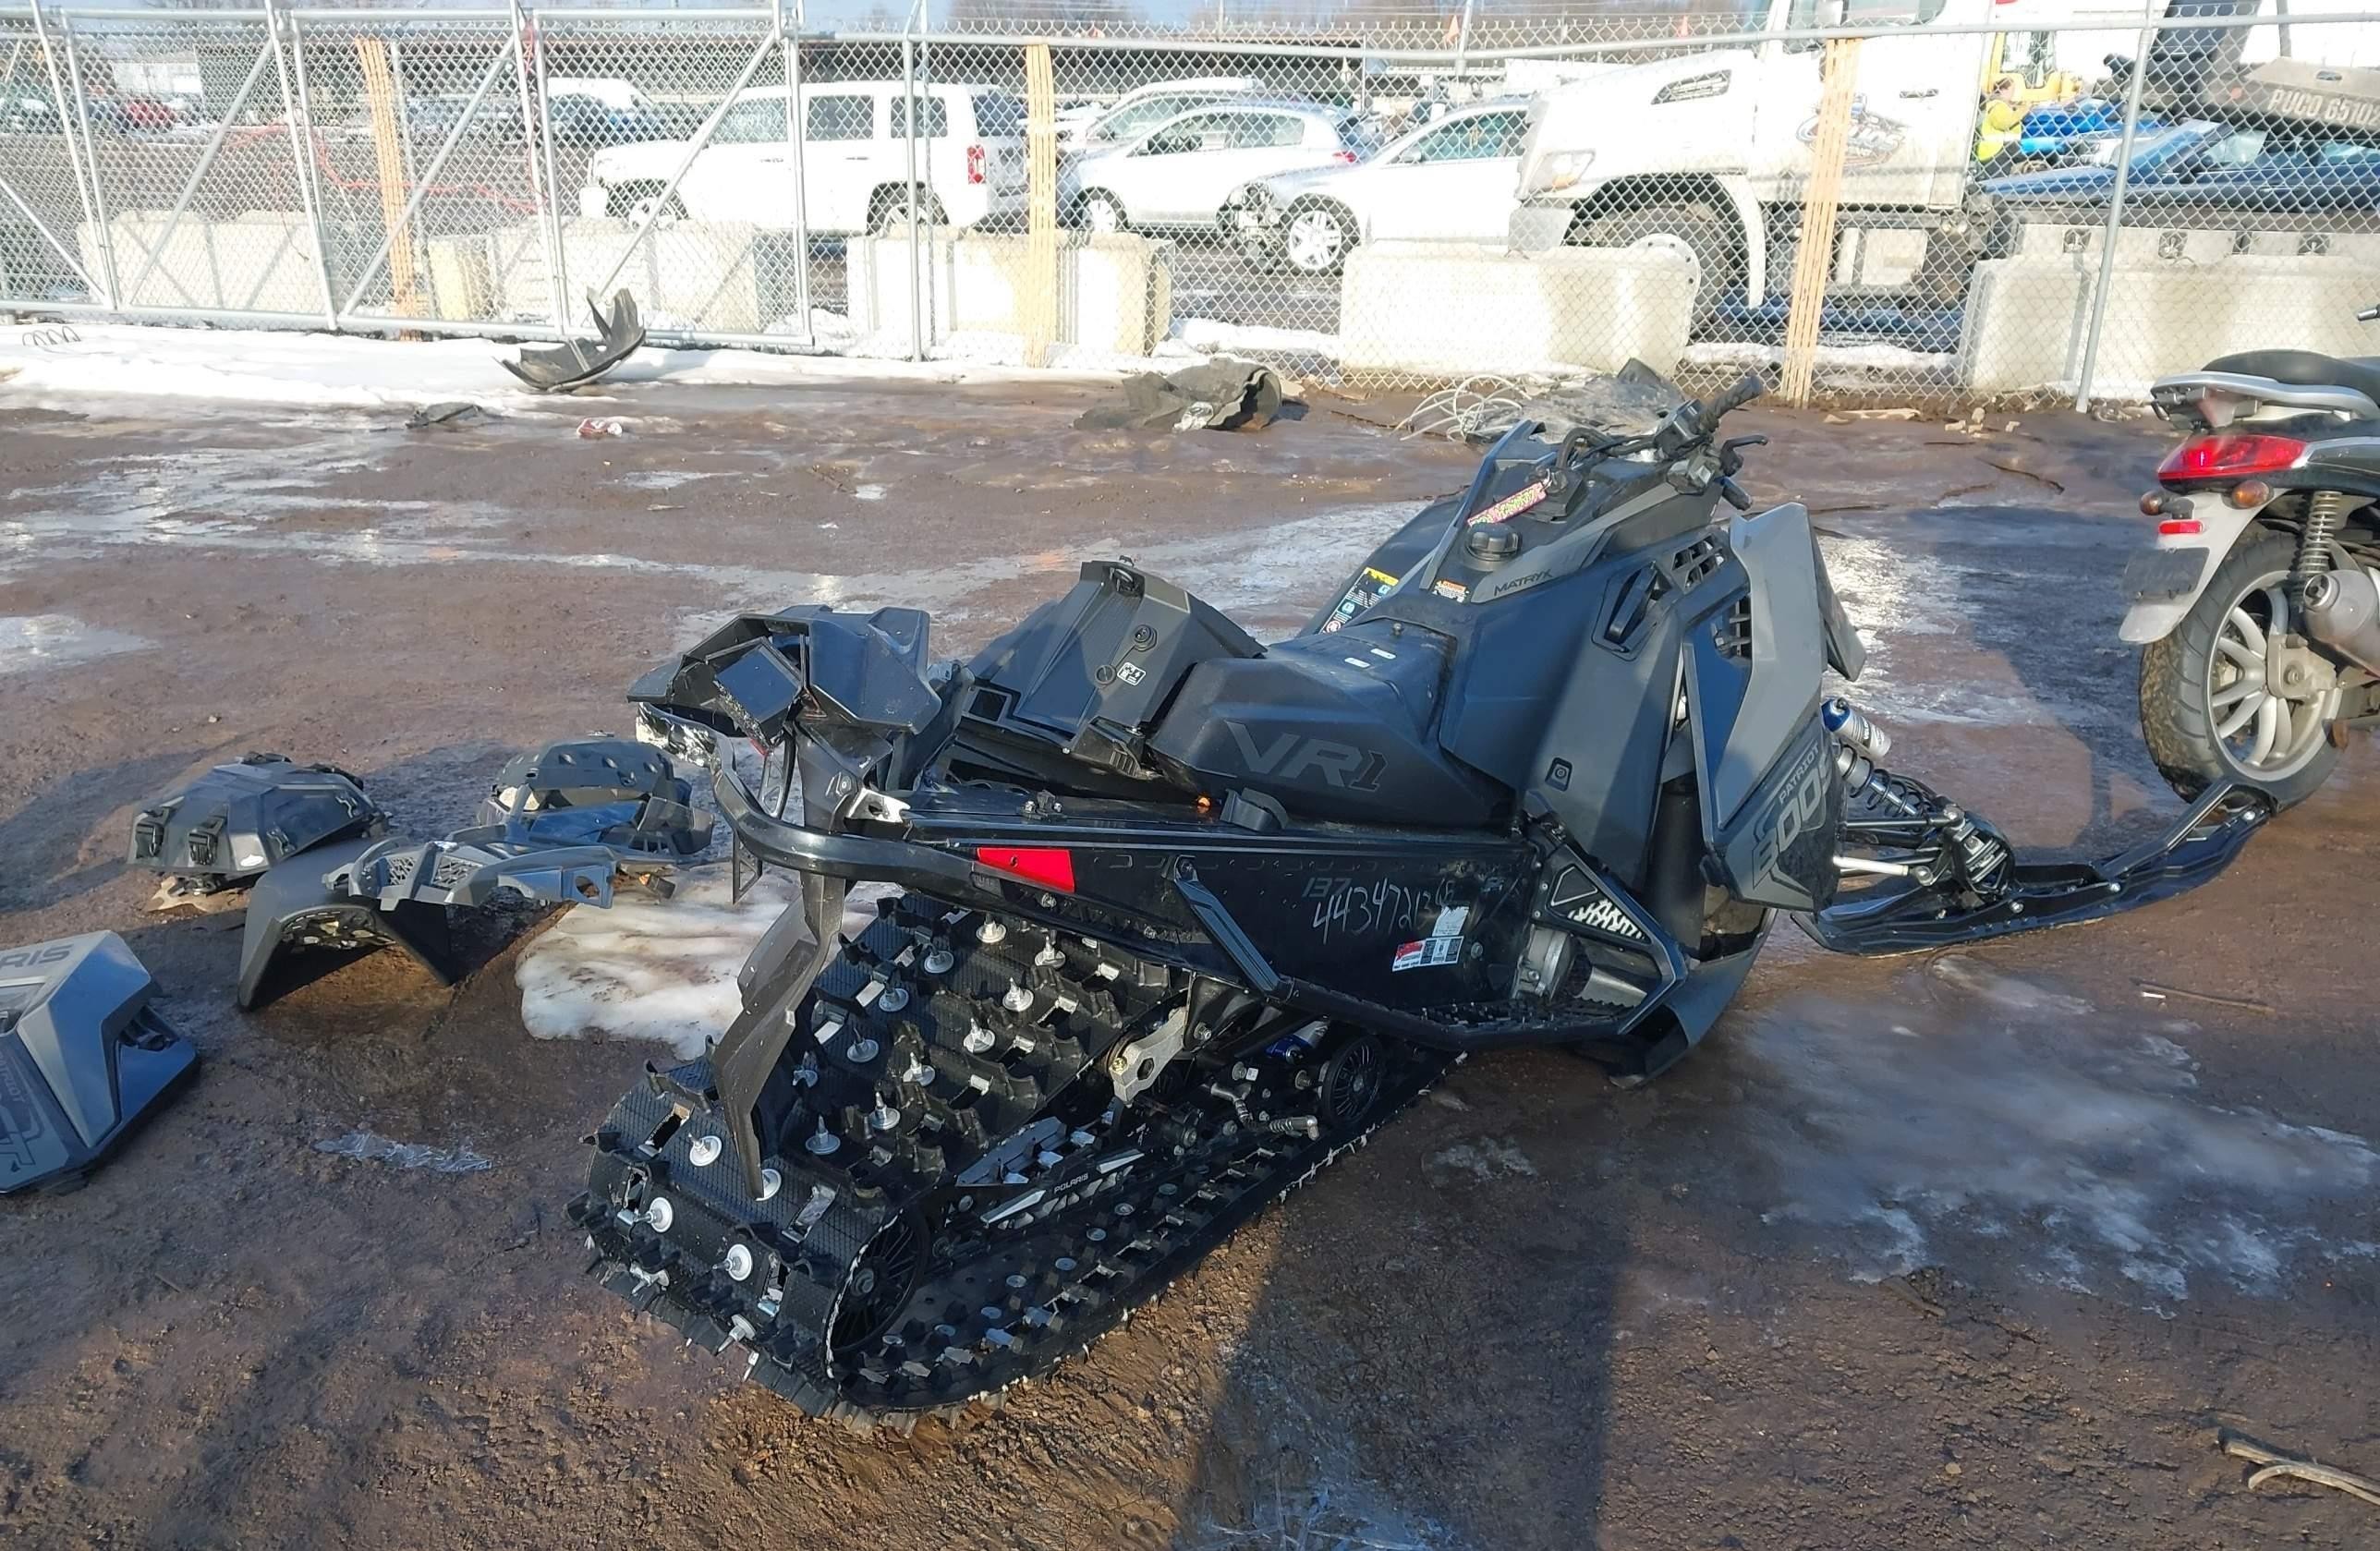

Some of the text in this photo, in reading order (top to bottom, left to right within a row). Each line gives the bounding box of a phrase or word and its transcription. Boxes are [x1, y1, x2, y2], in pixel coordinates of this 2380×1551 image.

[2267, 90, 2323, 117] PUCO
[1494, 568, 1553, 597] MATRYX
[1223, 720, 1389, 792] VR1
[1779, 740, 1819, 805] PATRIOT
[1302, 878, 1352, 898] 137
[1053, 1172, 1088, 1194] POLARIS
